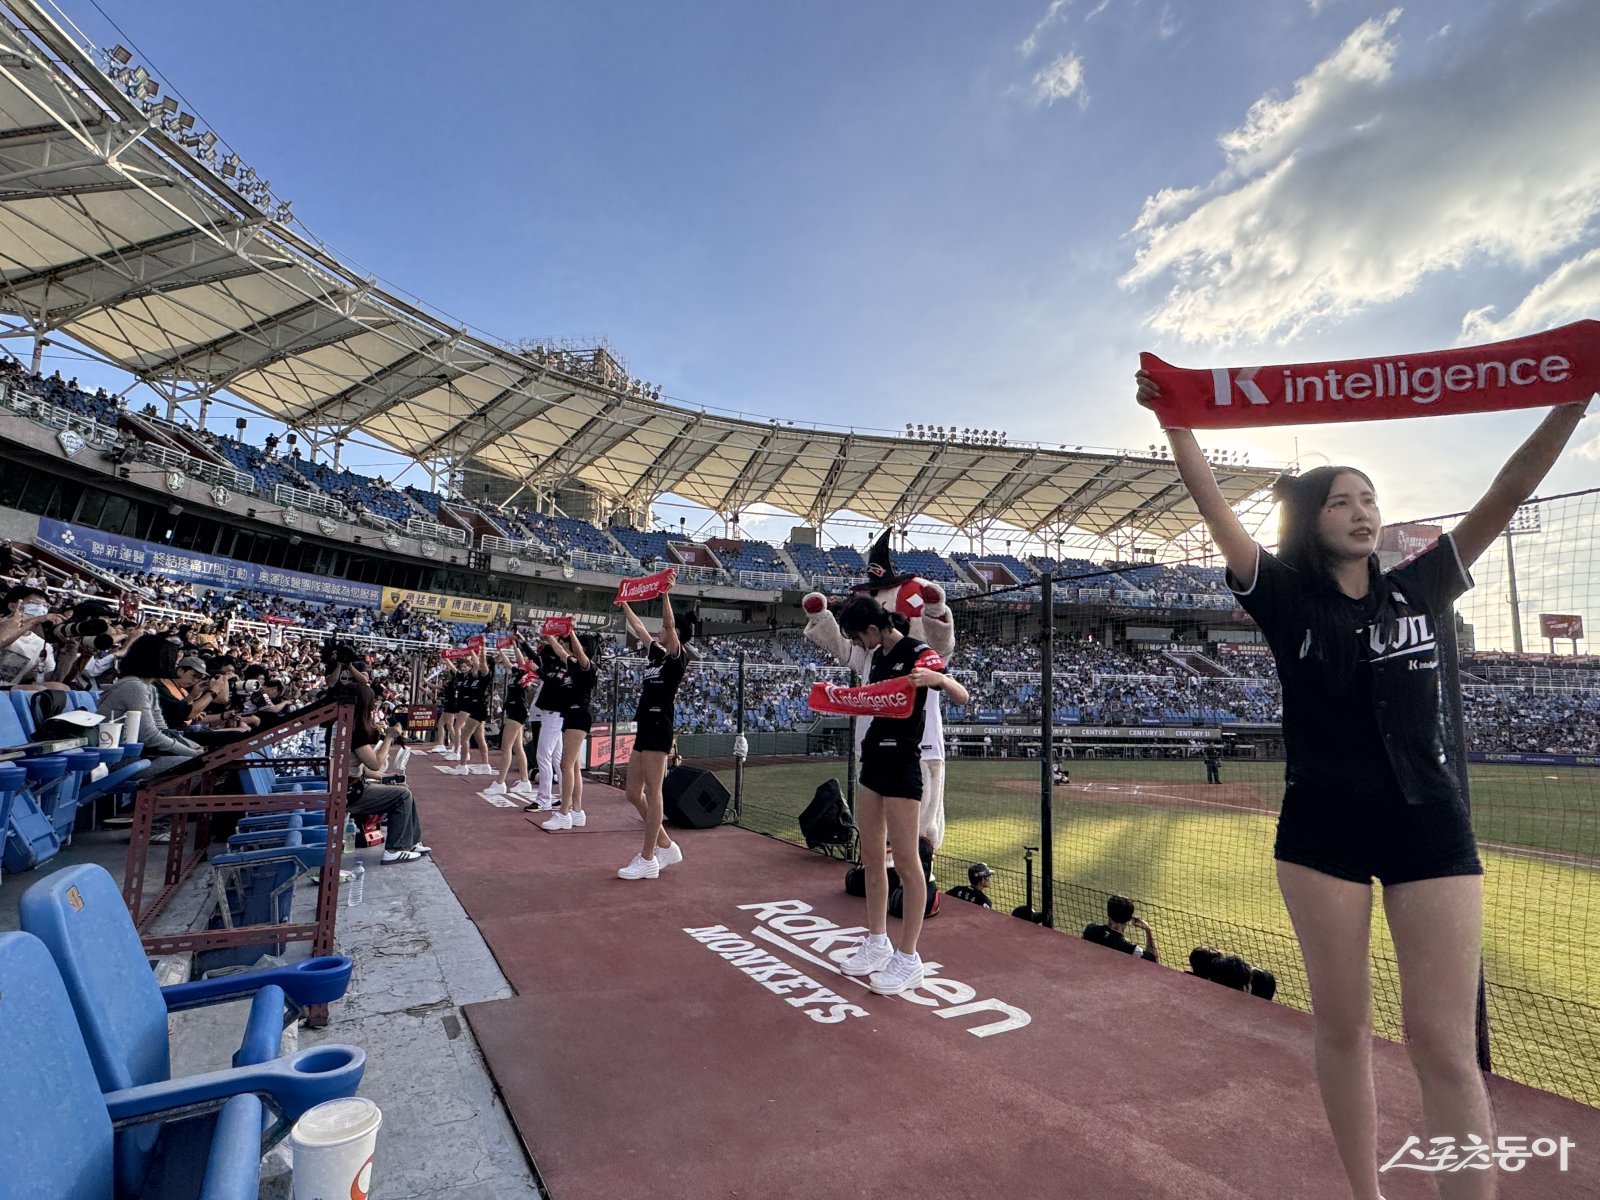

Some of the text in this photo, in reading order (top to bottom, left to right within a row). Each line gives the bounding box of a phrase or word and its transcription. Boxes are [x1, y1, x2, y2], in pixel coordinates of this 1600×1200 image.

[1211, 354, 1573, 406] K intelligence
[92, 541, 145, 564] 聯新運醫
[152, 550, 248, 580] 終結疼痛立即行動
[839, 690, 908, 711] intelligence
[682, 924, 871, 1024] MONKEYS
